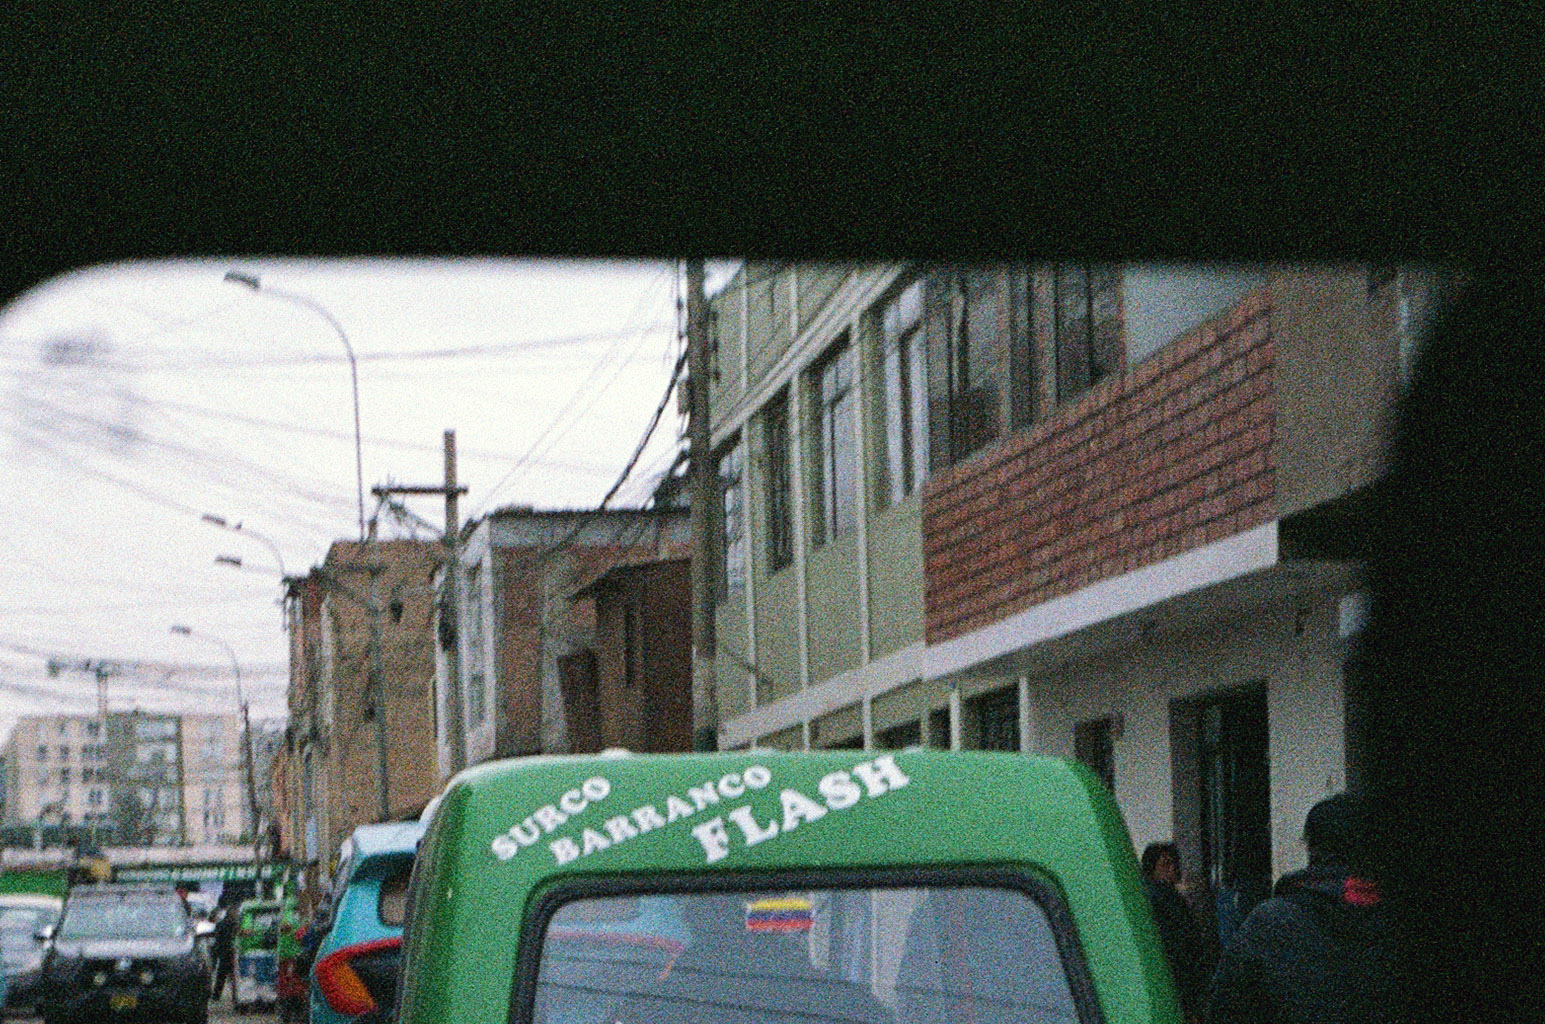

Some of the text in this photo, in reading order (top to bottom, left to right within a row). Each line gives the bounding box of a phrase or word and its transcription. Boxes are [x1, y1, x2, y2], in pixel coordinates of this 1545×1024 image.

[490, 775, 612, 861] SURCO
[548, 764, 773, 867] BARRANCO
[690, 755, 912, 864] FLASH
